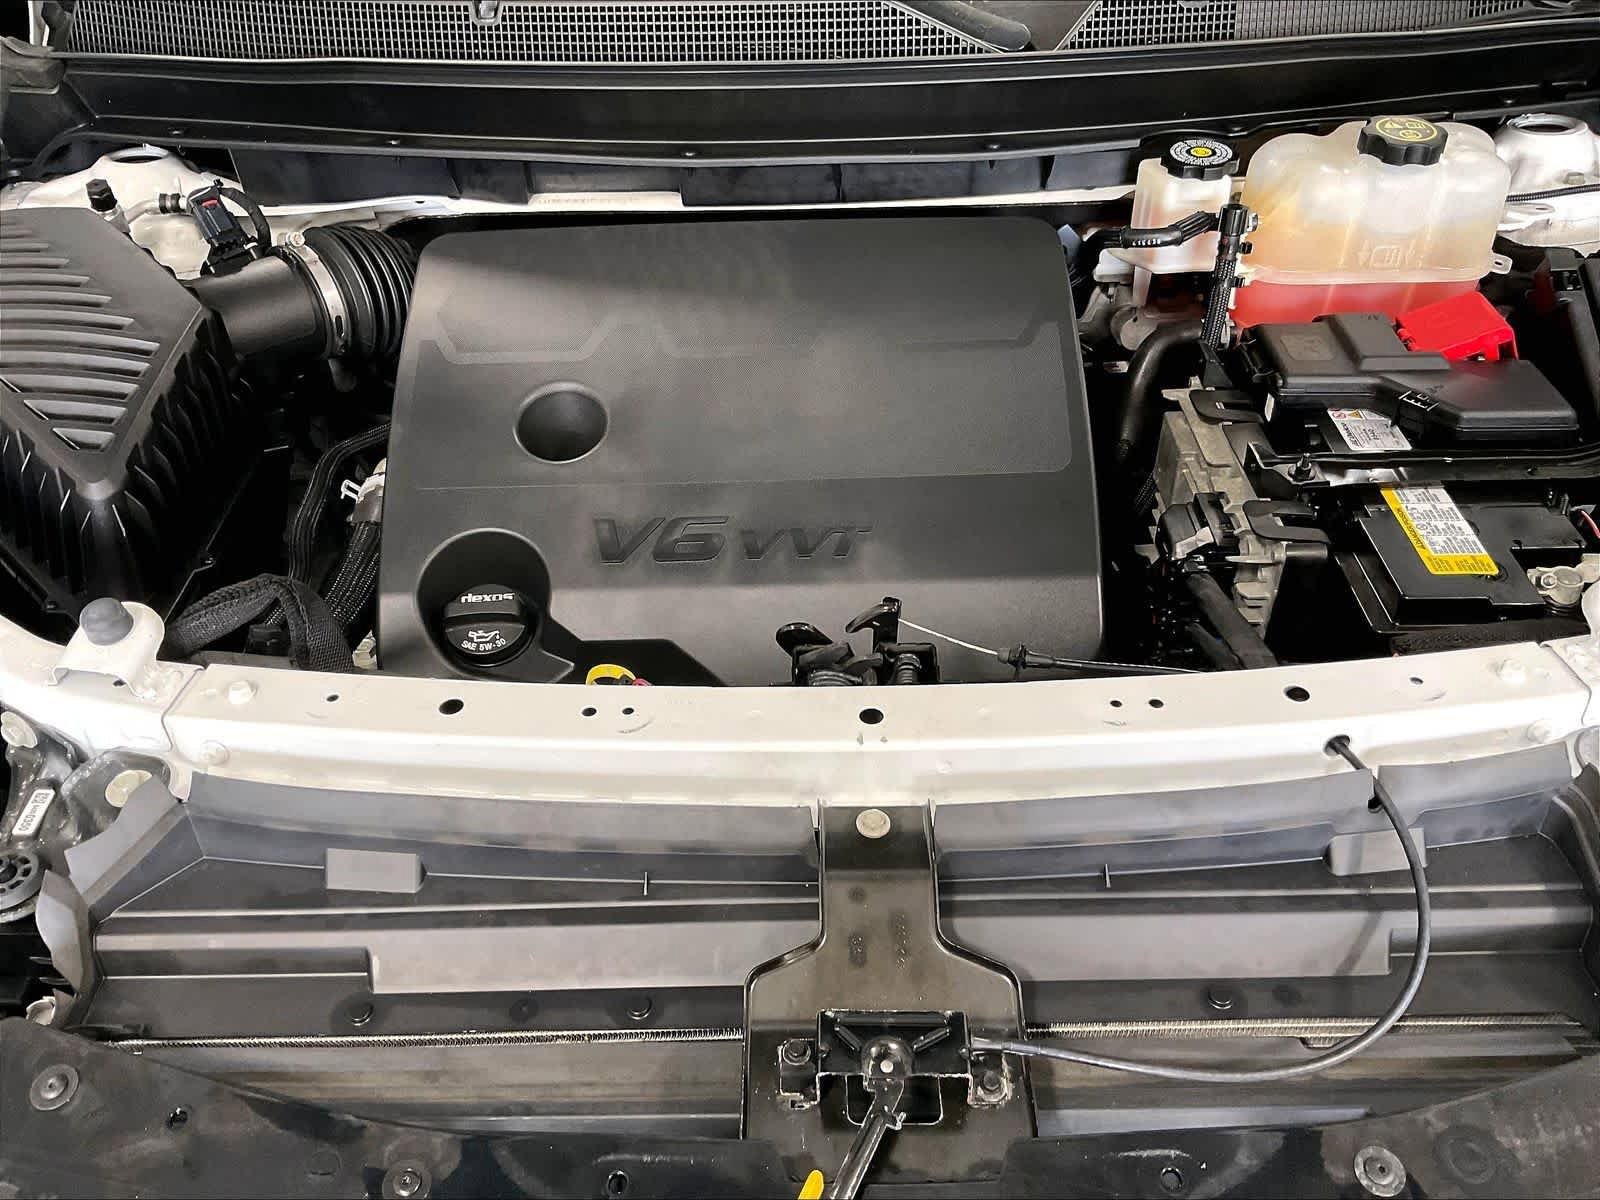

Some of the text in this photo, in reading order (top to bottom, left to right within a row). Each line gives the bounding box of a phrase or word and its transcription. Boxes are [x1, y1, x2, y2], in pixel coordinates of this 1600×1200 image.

[593, 516, 873, 565] V6 VVT
[461, 638, 506, 651] SAE 5W-30
